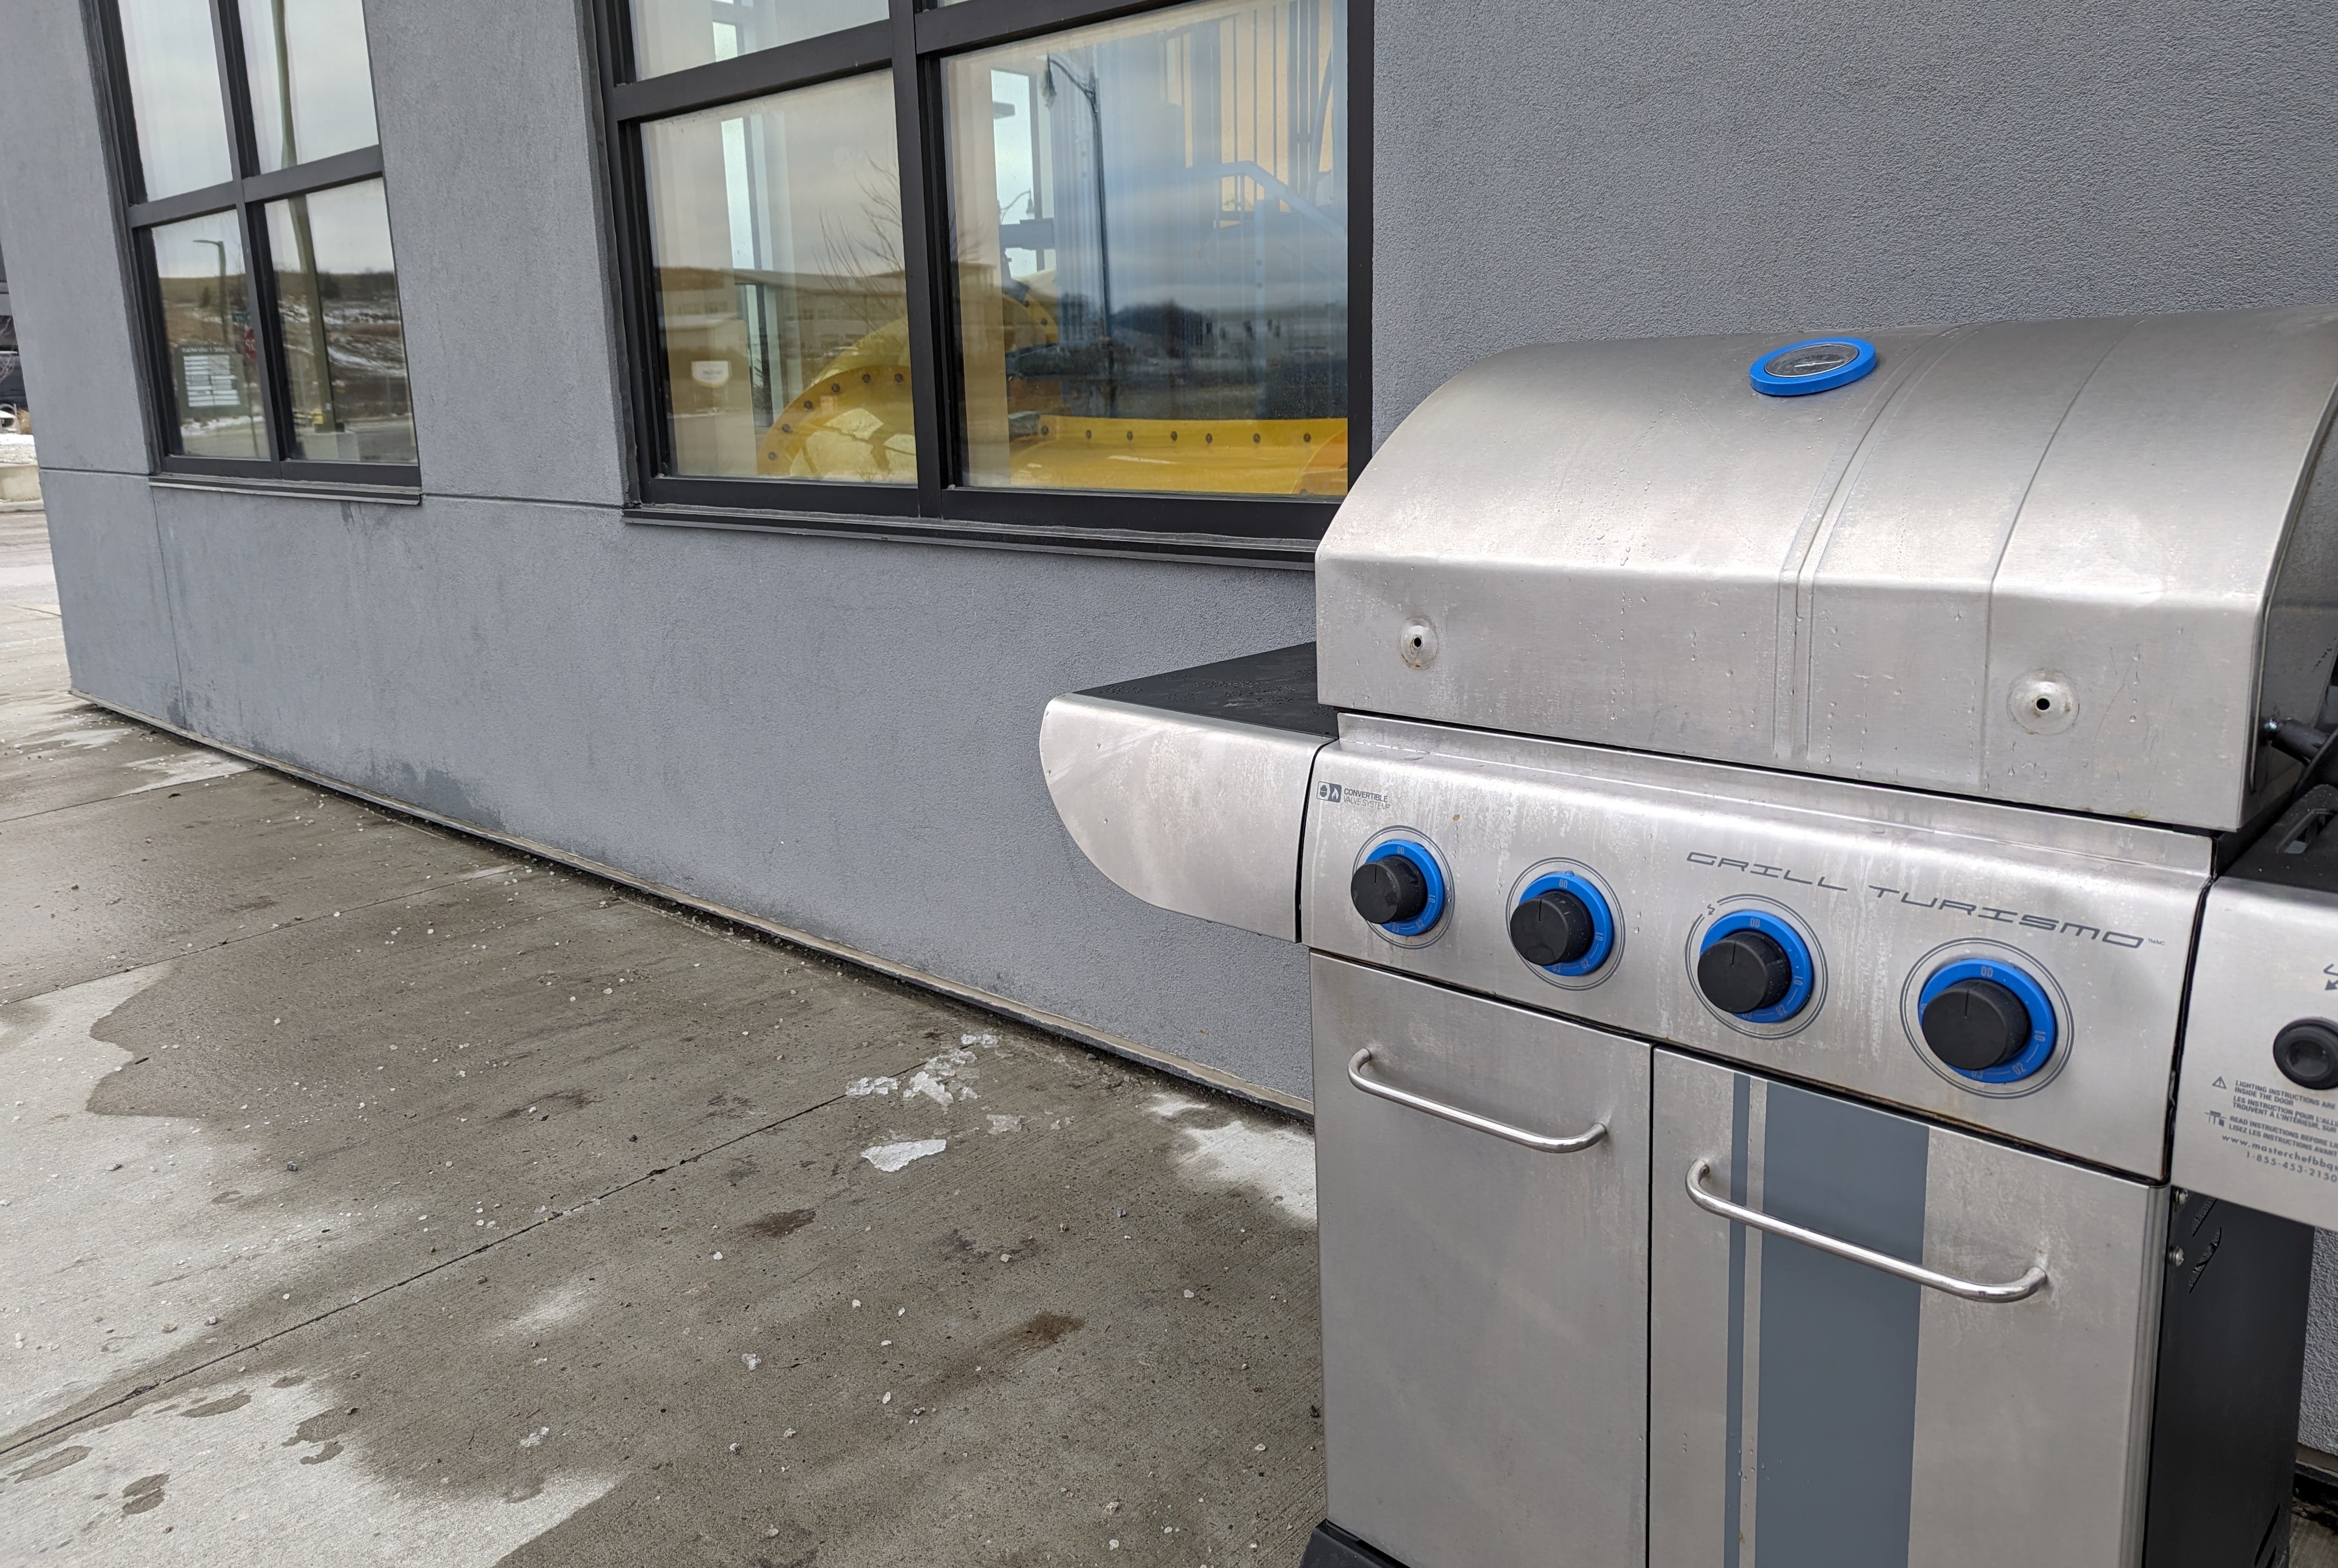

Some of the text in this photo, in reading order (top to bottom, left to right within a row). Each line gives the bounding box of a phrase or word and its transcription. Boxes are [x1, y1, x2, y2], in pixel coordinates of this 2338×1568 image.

[1344, 788, 1388, 802] CONVERTIBLE
[1344, 796, 1361, 805] VALVE
[1687, 852, 1848, 891] GRILL
[1868, 885, 2144, 948] TURISMO
[2233, 1095, 2246, 1103] LES
[2247, 1099, 2293, 1115] INSTRUCTION
[2295, 1111, 2314, 1121] POUR
[2235, 1080, 2336, 1110] LIGHTING INSTRUCTIONS ARE
[2235, 1087, 2294, 1106] INSIDE THE DOOR
[2230, 1115, 2248, 1126] READ
[2249, 1120, 2299, 1139] INSTRUCTIONS
[2300, 1134, 2328, 1146] BEFORE
[2233, 1102, 2267, 1115] TROUVENT
[2322, 1125, 2337, 1133] SUR
[2228, 1123, 2337, 1157] LISEZ LES INSTRUCTIONS AVANT
[2246, 1151, 2338, 1182] 1-855-453-2150
